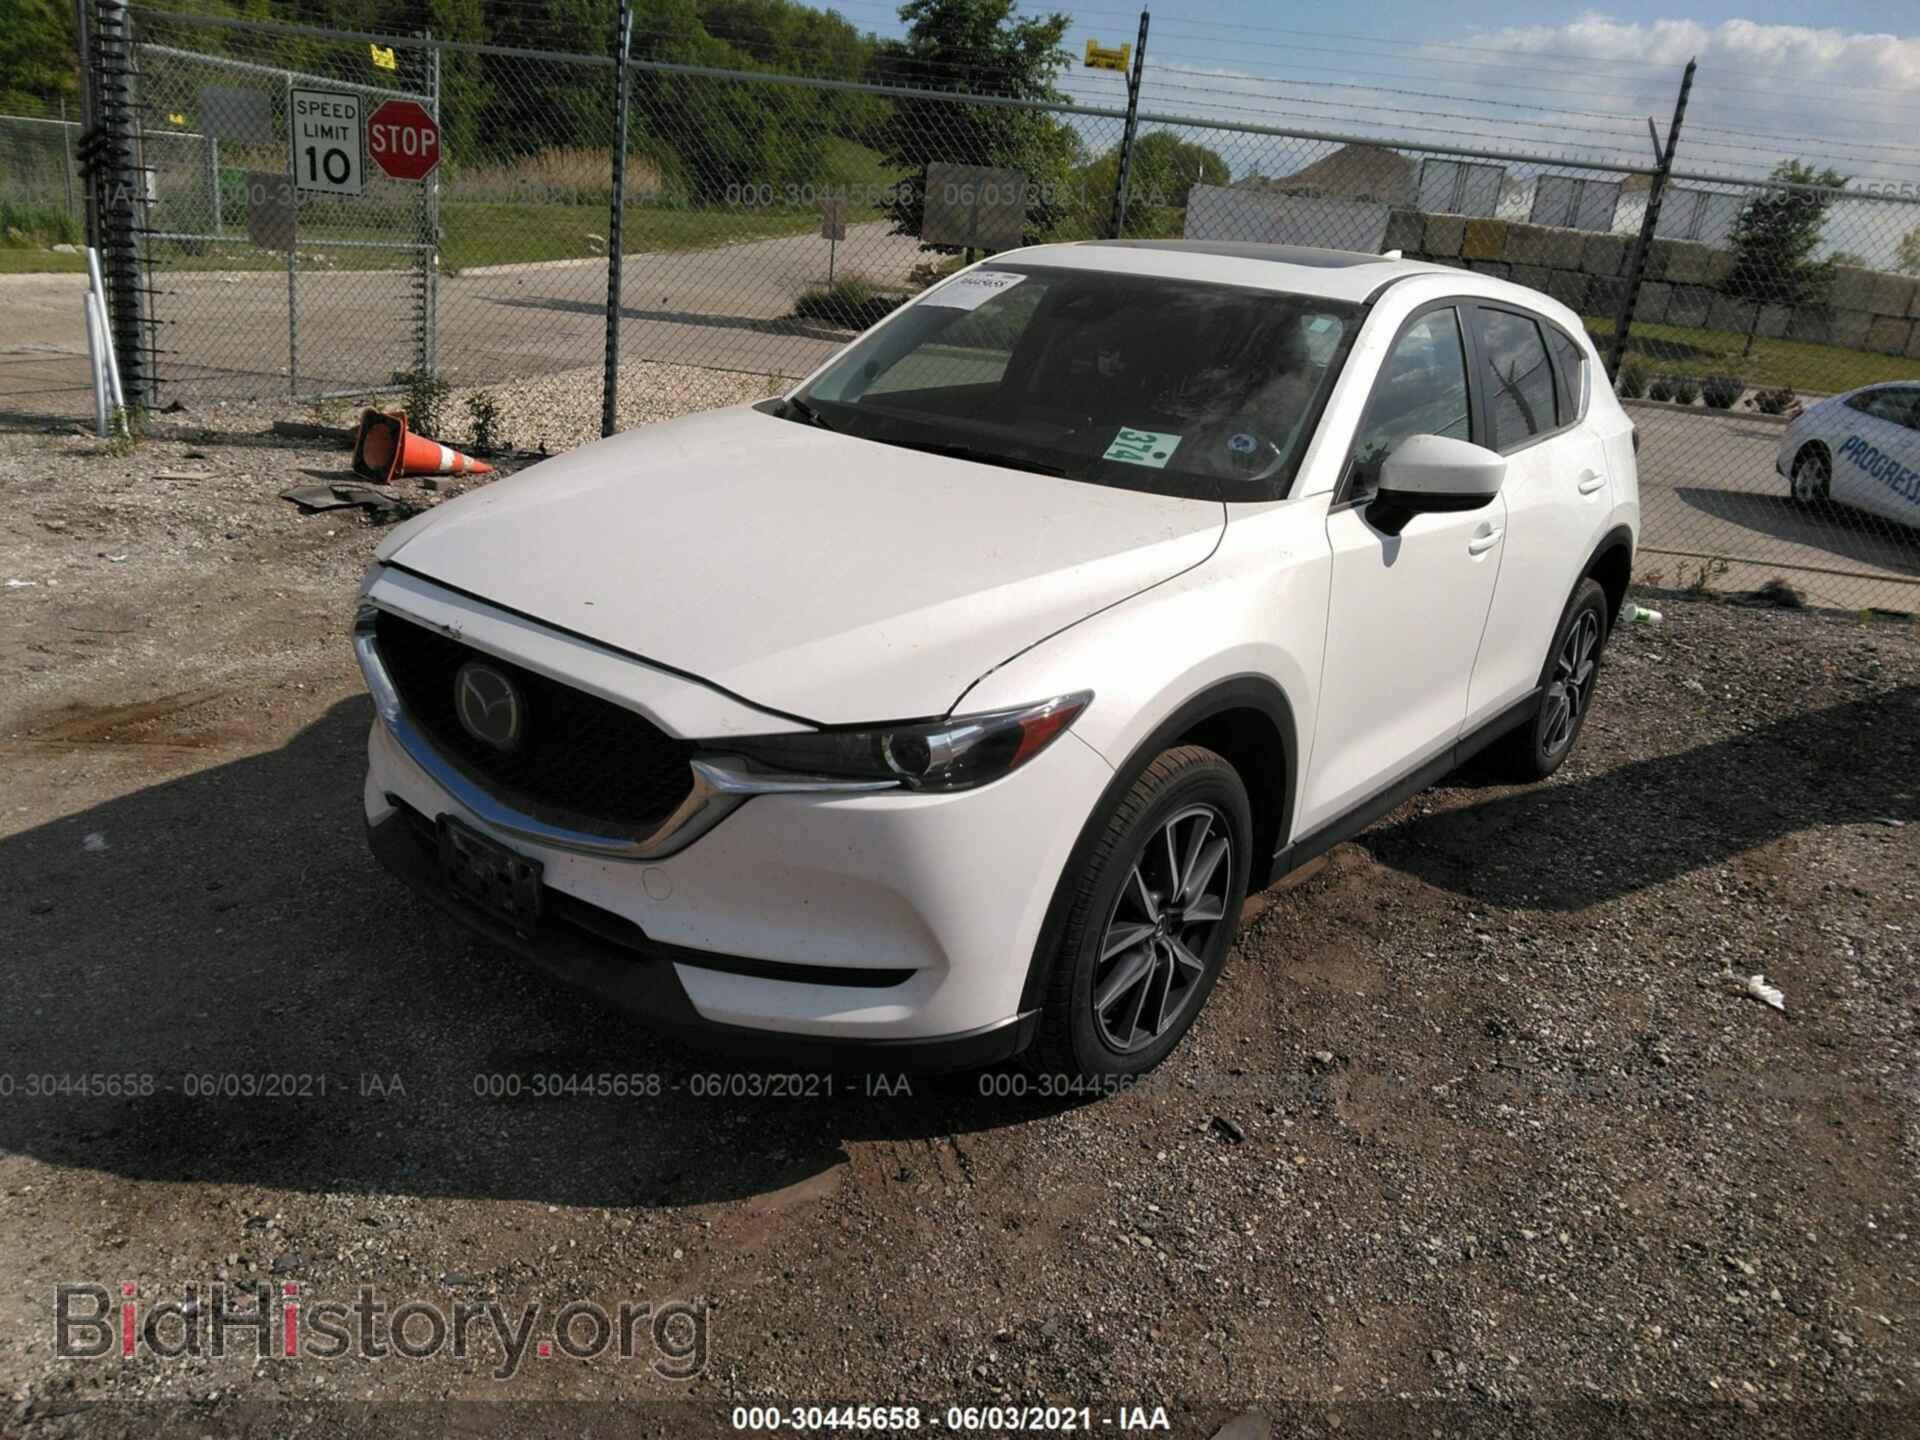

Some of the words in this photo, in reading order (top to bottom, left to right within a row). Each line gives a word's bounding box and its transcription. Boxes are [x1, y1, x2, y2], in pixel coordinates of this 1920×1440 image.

[297, 100, 356, 120] SPEED
[304, 123, 350, 141] LIMIT
[371, 123, 436, 157] STOP
[305, 145, 351, 185] 10
[1106, 430, 1158, 462] 374
